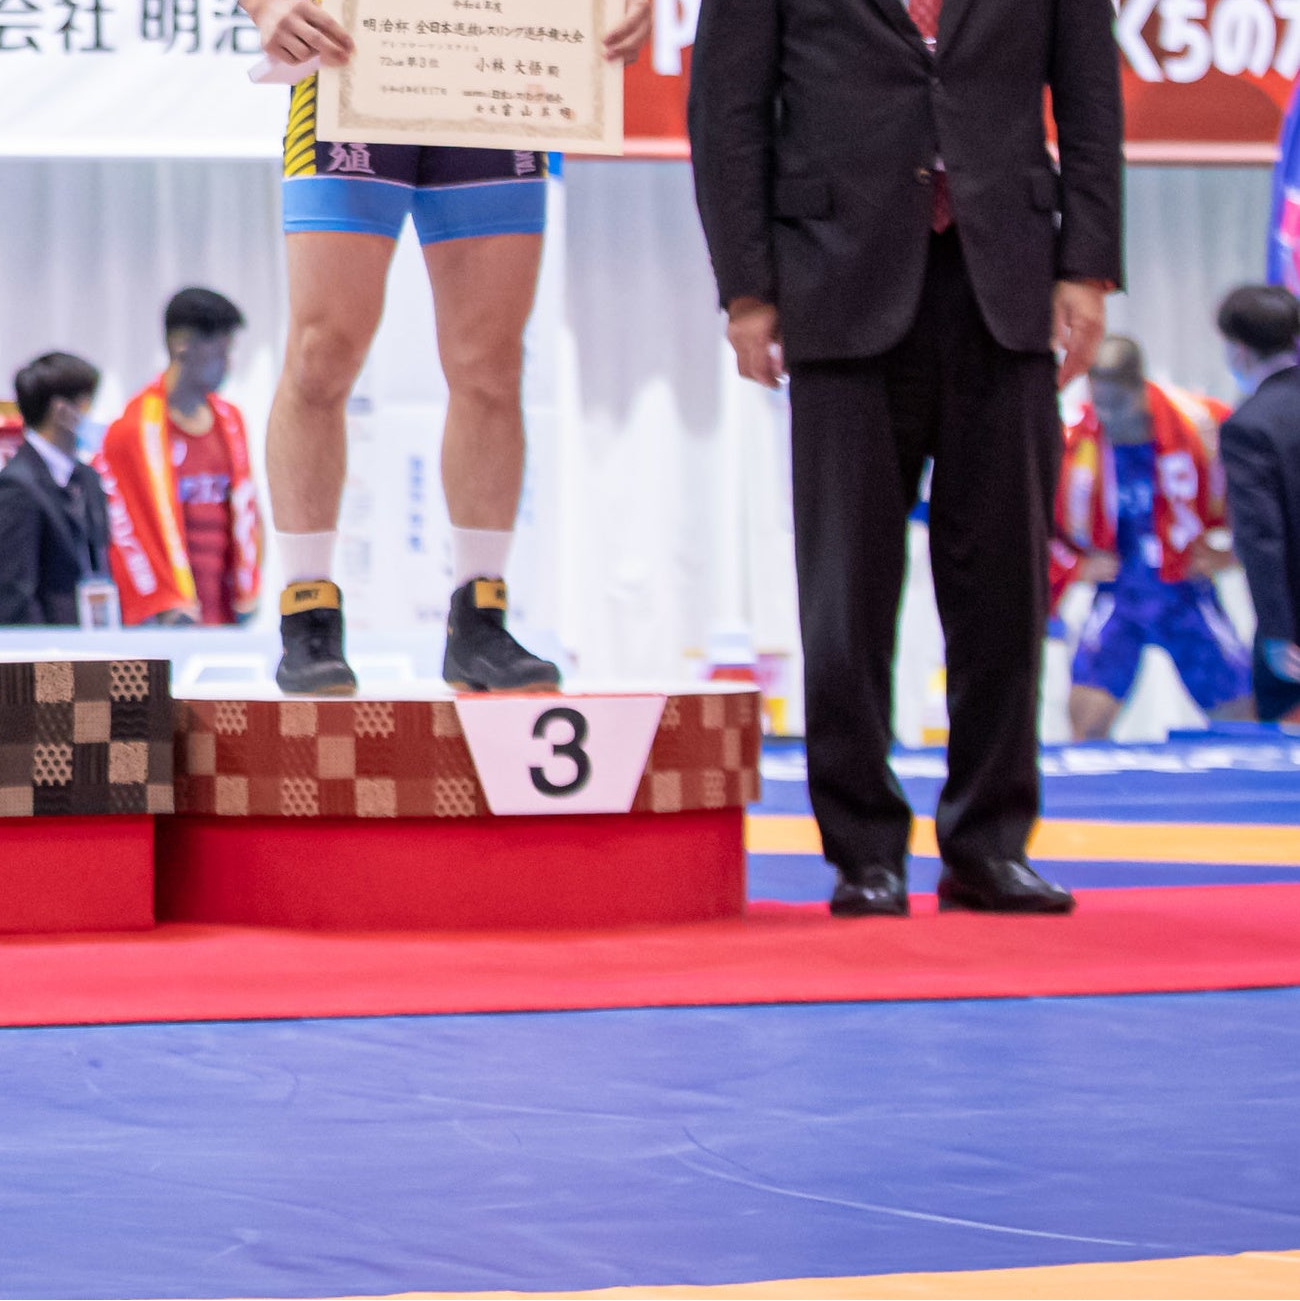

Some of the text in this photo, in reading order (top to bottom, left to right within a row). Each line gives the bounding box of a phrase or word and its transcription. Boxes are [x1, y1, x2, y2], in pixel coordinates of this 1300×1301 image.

[362, 17, 410, 34] 明治杯
[529, 707, 592, 797] 3
